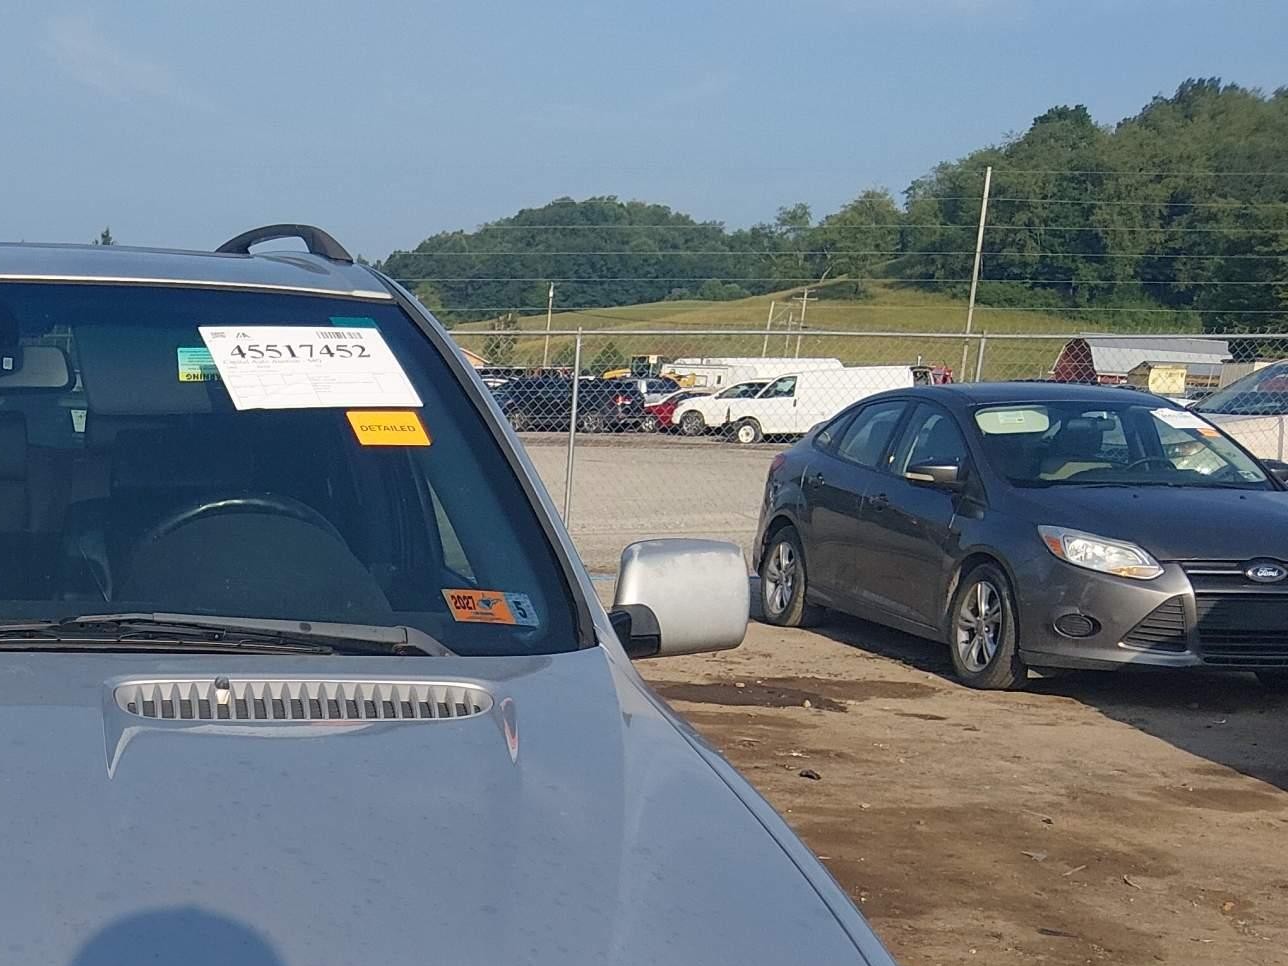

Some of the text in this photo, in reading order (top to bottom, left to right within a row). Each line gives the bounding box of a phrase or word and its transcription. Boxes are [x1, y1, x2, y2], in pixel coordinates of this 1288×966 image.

[230, 344, 371, 359] 45517452
[360, 424, 416, 432] DETAILED
[1257, 567, 1279, 577] Ford
[451, 595, 476, 610] 2027
[512, 600, 527, 619] 5
